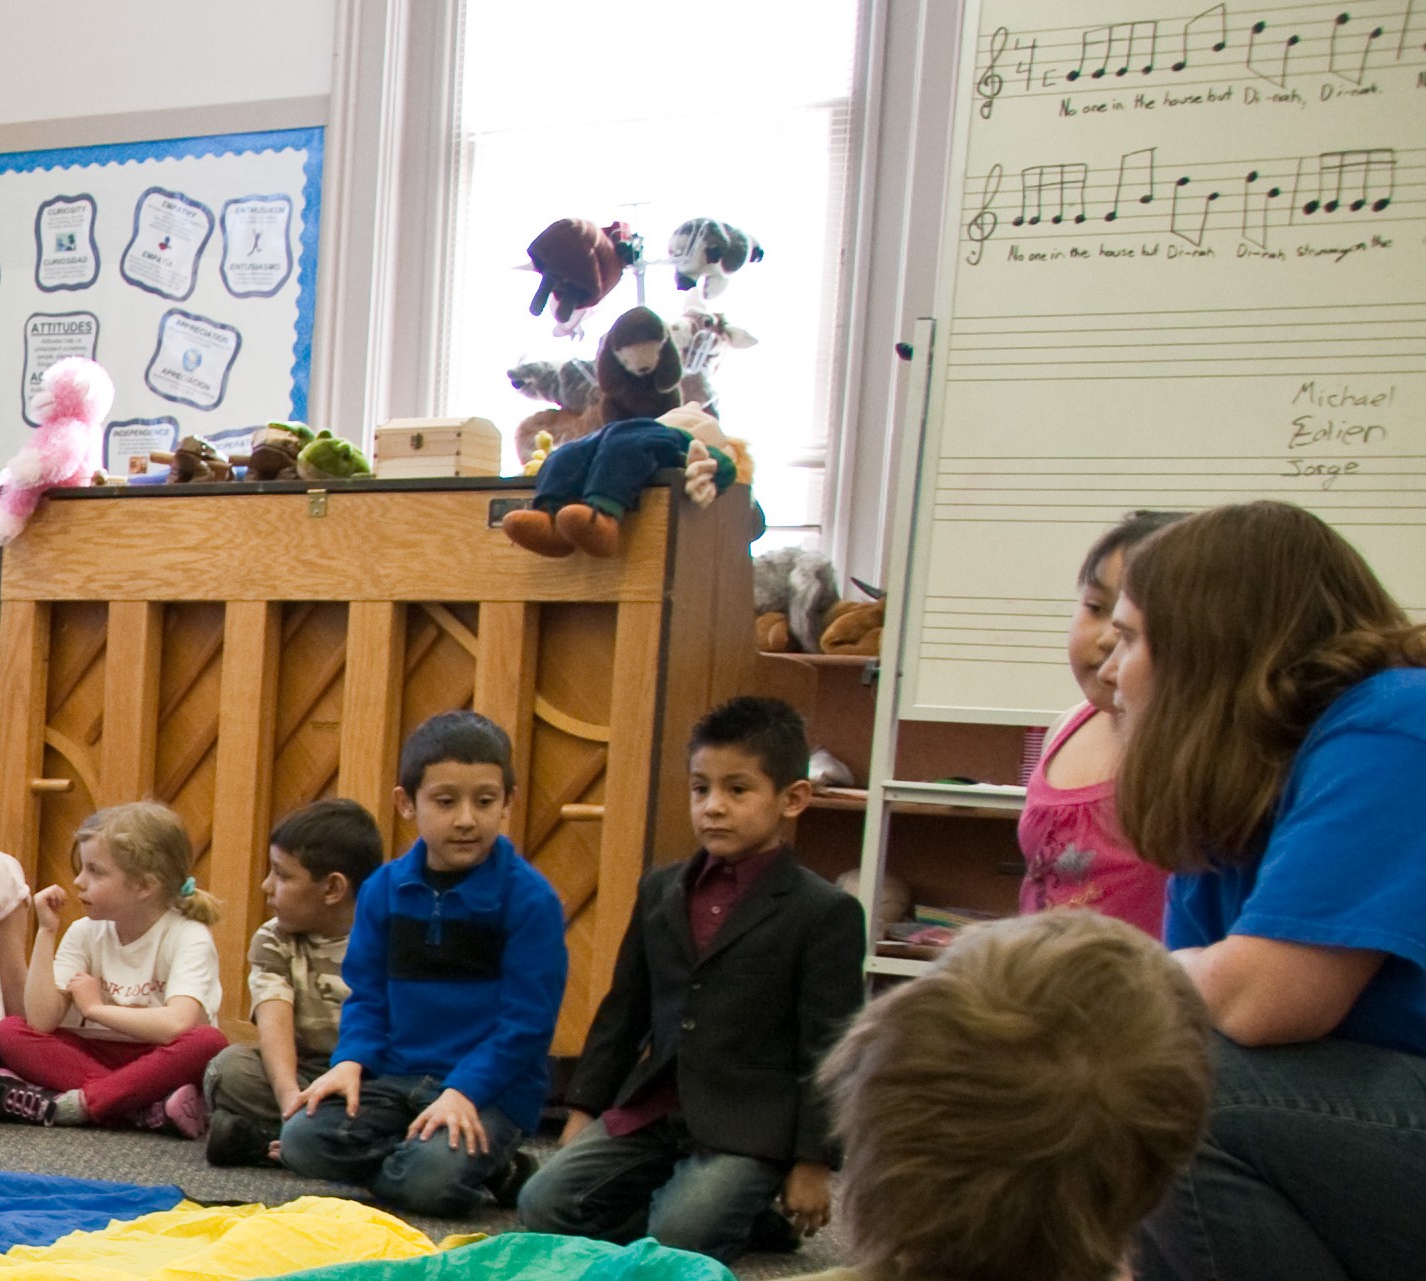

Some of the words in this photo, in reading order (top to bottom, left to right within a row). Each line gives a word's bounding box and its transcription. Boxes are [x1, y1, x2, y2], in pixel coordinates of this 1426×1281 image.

[1059, 98, 1077, 117] No
[1082, 103, 1107, 113] one
[1112, 101, 1125, 110] in
[1134, 94, 1155, 110] the
[1163, 91, 1202, 105] house
[1007, 244, 1024, 261] No
[1028, 252, 1047, 261] one
[1050, 248, 1065, 260] in
[1070, 247, 1091, 260] the
[1098, 243, 1135, 258] house
[30, 321, 93, 335] ATTITUDES
[1291, 380, 1396, 408] Michael
[1280, 459, 1360, 491] Jorge
